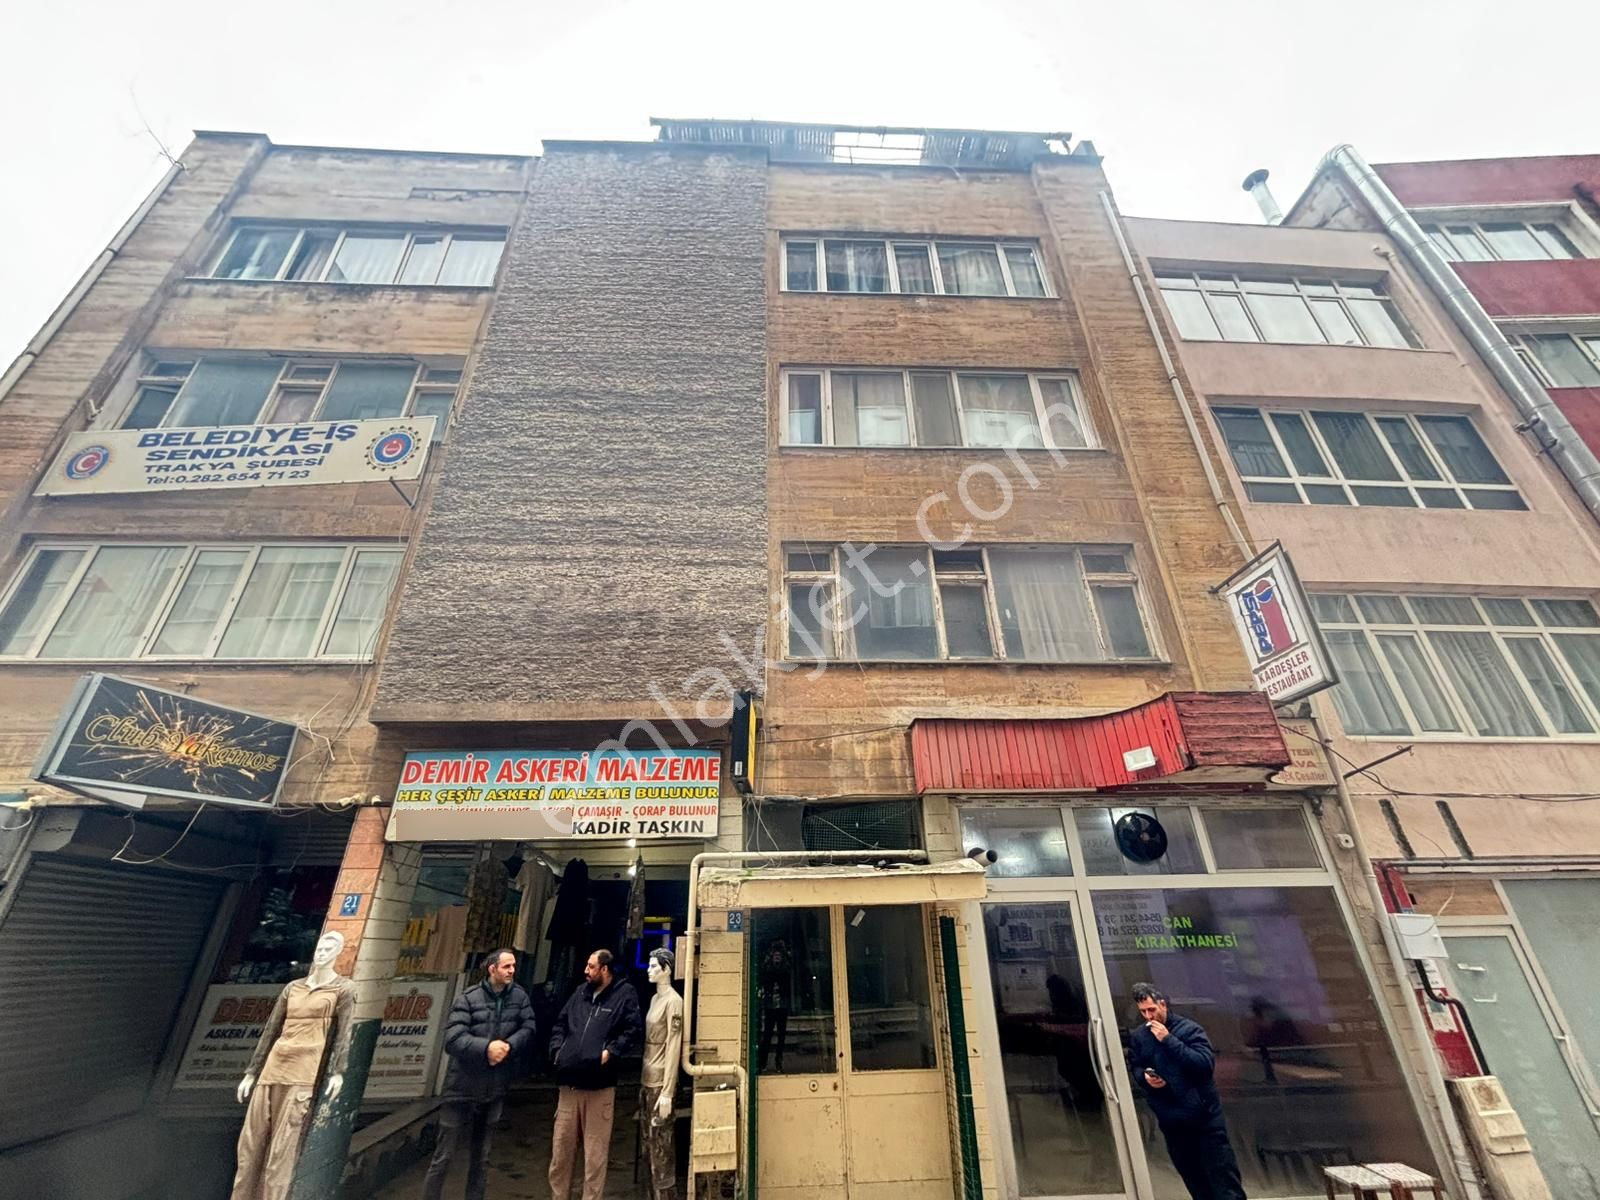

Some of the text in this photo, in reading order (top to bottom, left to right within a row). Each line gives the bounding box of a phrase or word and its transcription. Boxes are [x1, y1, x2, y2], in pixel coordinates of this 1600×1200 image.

[137, 423, 358, 448] BELEDİYE-İŞ
[146, 443, 333, 461] SENDİKASI
[144, 456, 326, 473] TRAKYA ŞUBESİ
[145, 470, 310, 485] Tel:0.282.654 71 23
[1241, 591, 1274, 655] PEPSI
[1257, 650, 1309, 684] KARDEŞLER
[85, 714, 166, 748] Club
[168, 731, 280, 772] Yakamoz
[402, 752, 720, 784] DEMİR ASKERİ MALZEME
[397, 786, 719, 804] HER ÇEŞİT ASKERİ MALZEME BULUNUR
[578, 806, 622, 820] ÇAMAŞIR
[633, 805, 666, 818] ÇORAP
[669, 804, 718, 816] BULUNUR
[572, 818, 704, 837] KADİR TAŞKIN
[344, 895, 358, 908] 21
[729, 912, 741, 924] 23
[1163, 916, 1193, 929] CAN
[1135, 931, 1238, 949] KIRAATHANESİ
[211, 996, 278, 1025] DEM
[384, 987, 433, 1022] MİR
[204, 1026, 246, 1039] ASKERİ
